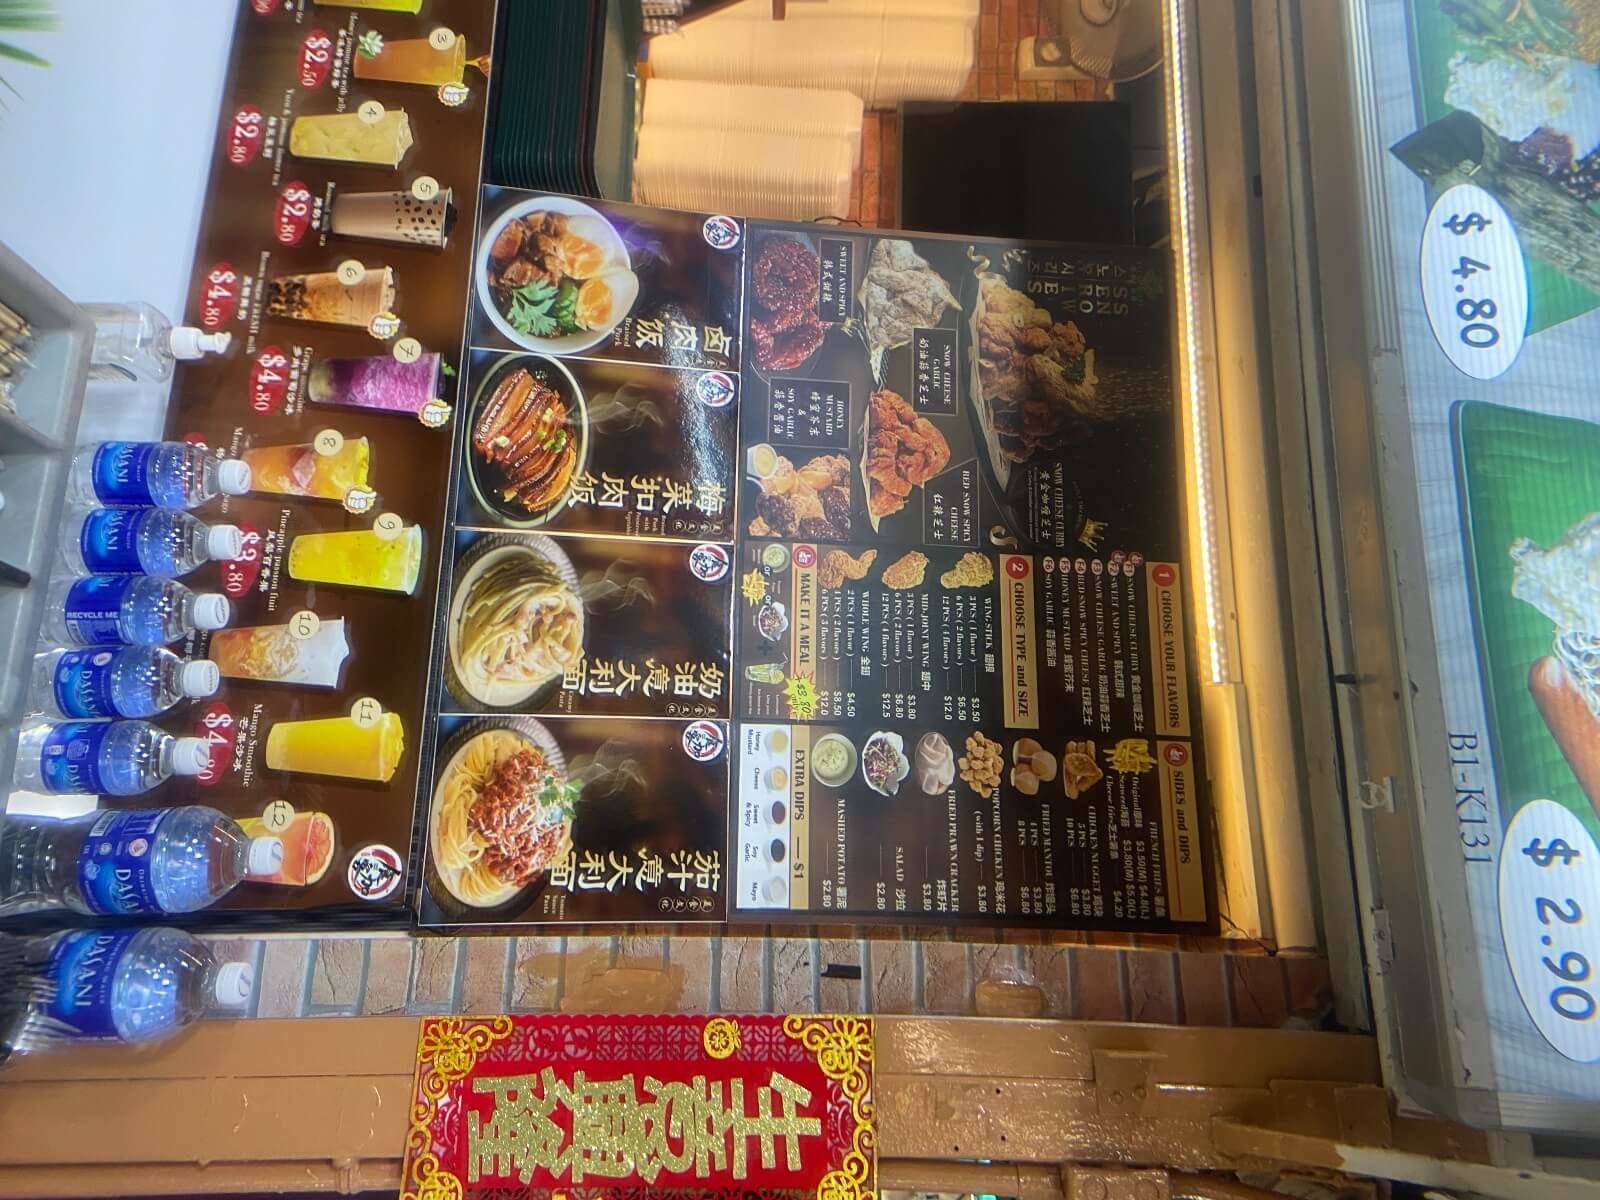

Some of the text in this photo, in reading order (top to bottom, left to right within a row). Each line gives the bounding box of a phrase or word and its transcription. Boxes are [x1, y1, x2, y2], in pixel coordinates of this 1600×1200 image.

[437, 34, 447, 43] 3
[303, 37, 331, 87] $2.50
[366, 107, 376, 117] 4
[231, 112, 261, 162] $2.80
[420, 182, 430, 193] 5
[279, 188, 311, 241] $2.80
[204, 270, 236, 325] $4.80
[838, 245, 847, 317] SWEET AND SPICY
[1027, 281, 1128, 298] SERIES
[1442, 213, 1500, 348] $ 4.80
[1062, 300, 1128, 315] SNOW
[400, 344, 414, 357] 7
[614, 328, 622, 346] Pork
[635, 318, 732, 357] 卤肉饭
[254, 354, 286, 410] $4.80
[933, 358, 941, 389] GARLIC
[786, 388, 795, 440] SOY GARLIC
[825, 394, 834, 435] MUSTARD
[836, 400, 844, 429] HONEY
[323, 437, 336, 448] 8
[568, 471, 727, 516] 梅菜扣肉饭
[962, 470, 970, 488] RED
[107, 511, 128, 550] DASANI
[276, 509, 291, 553] Pineapple
[378, 520, 395, 530] 9
[299, 614, 311, 636] 10
[800, 573, 810, 666] MAKE IT A MEAL
[861, 591, 870, 625] WHOLE
[1161, 591, 1173, 635] CHOOSE
[861, 627, 870, 653] WING
[1012, 563, 1028, 717] 2 CHOOSE TYPE and SIZE
[1164, 641, 1176, 671] YOUR
[81, 671, 100, 715] DASANI
[562, 658, 724, 699] 奶油意大利面
[359, 700, 373, 723] 11
[820, 690, 829, 715] $12.0
[833, 691, 842, 716] $8.50
[847, 692, 856, 717] $4.50
[882, 693, 890, 718] $12.5
[895, 693, 903, 718] $6.80
[907, 695, 916, 719] $3.80
[944, 696, 952, 720] $12.0
[957, 696, 966, 720] $6.50
[971, 697, 980, 722] $3.50
[1167, 676, 1179, 728] FLAVORS
[233, 717, 249, 772] 芒果沙冰
[242, 704, 263, 788] Mango Smoothie
[271, 801, 286, 828] 12
[794, 750, 804, 879] EXTRA DIPS $1
[948, 790, 956, 820] FRIED
[1448, 732, 1493, 864] B1-K131
[1174, 771, 1190, 864] SIDES and DIPS
[837, 799, 846, 884] MASHED POTATO
[550, 848, 721, 892] 茄汁意大利面
[895, 847, 905, 911] SALAD 沙拉
[823, 880, 832, 907] $2.80
[877, 882, 886, 910] $2.80
[922, 883, 931, 911] $3.80
[950, 863, 959, 912] CRACKER
[978, 885, 987, 912] $3.80
[1523, 838, 1596, 1021] $ 2.90
[74, 936, 114, 1006] DASANI
[467, 1067, 823, 1185] 生意興隆
